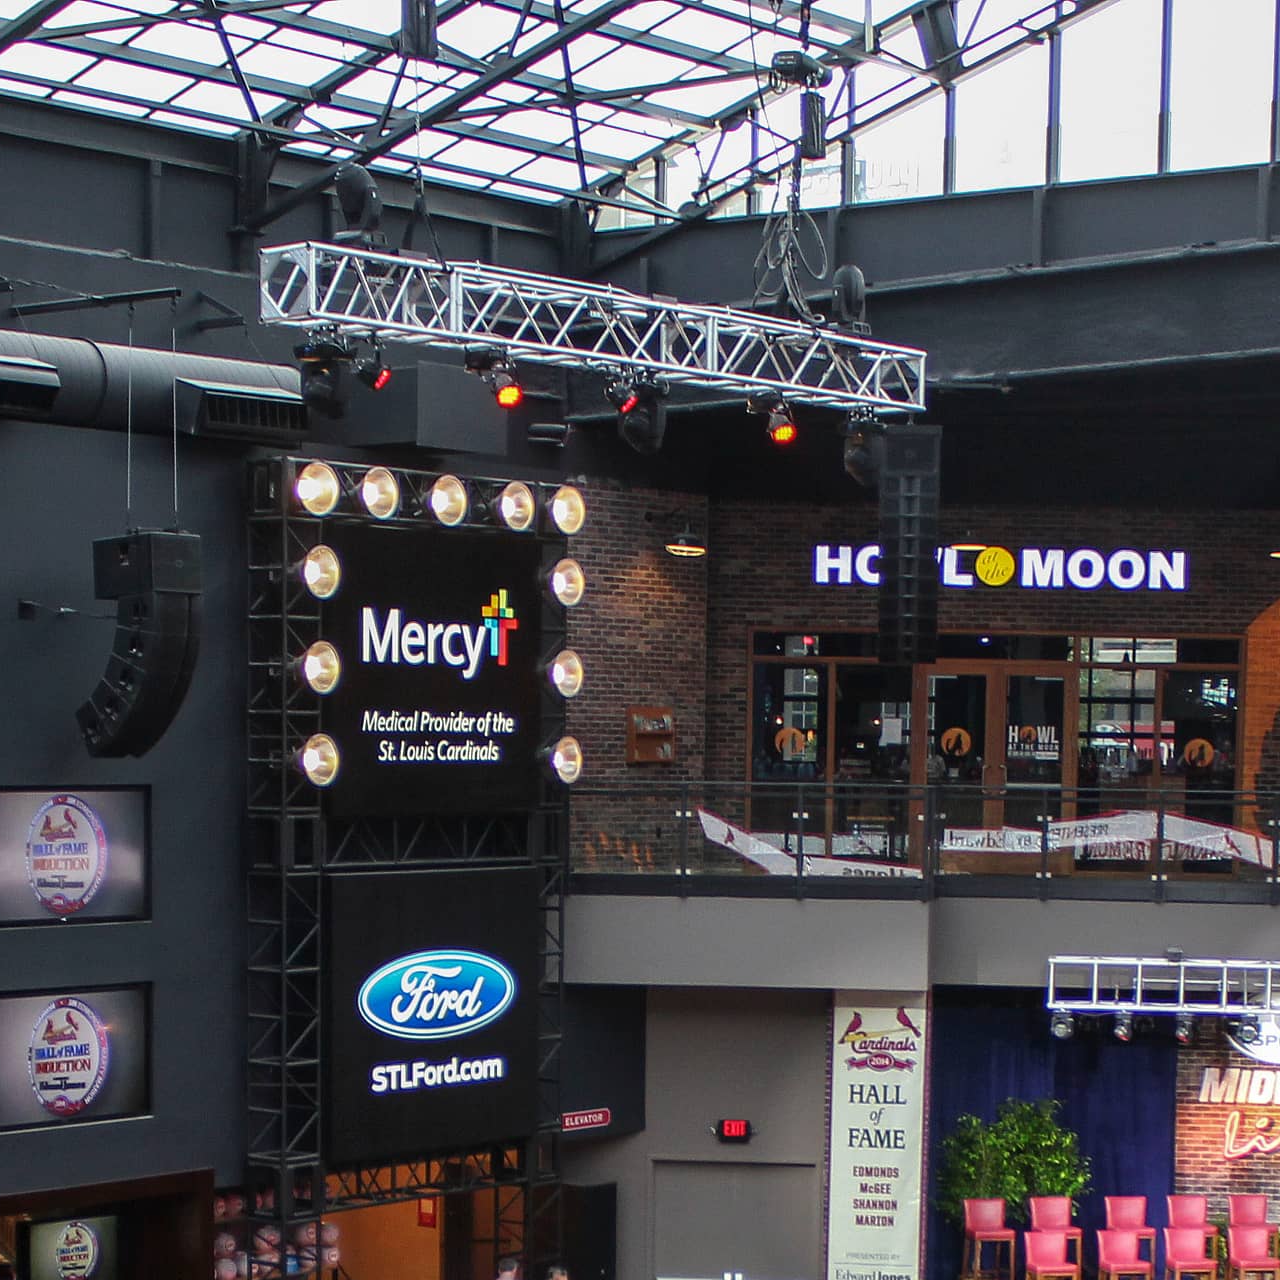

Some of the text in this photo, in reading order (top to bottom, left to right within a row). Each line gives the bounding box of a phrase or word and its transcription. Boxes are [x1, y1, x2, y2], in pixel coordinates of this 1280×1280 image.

[815, 545, 973, 586] HOL
[984, 559, 1010, 580] the
[1021, 548, 1185, 590] MOON
[361, 607, 486, 679] Mercy
[362, 711, 514, 736] Medical Provider of the
[378, 740, 499, 761] St. Louis Cardinals
[61, 842, 88, 855] FAME
[33, 857, 89, 870] INDUCTION
[391, 965, 484, 1023] Ford
[35, 1046, 57, 1060] HALL
[64, 1043, 90, 1057] FAME
[852, 1032, 917, 1054] Cardinals
[35, 1059, 90, 1073] INDUCTION
[870, 1055, 890, 1065] 2014
[372, 1057, 503, 1092] STLFord.com
[848, 1084, 907, 1105] HALL
[565, 1113, 603, 1127] ELEVATOR
[869, 1107, 885, 1126] of
[723, 1120, 747, 1137] EXIT
[848, 1128, 906, 1149] FAME
[853, 1166, 899, 1178] EDMONDS
[860, 1183, 892, 1195] McGEE
[853, 1199, 897, 1210] SHANNON
[855, 1215, 894, 1226] MARION
